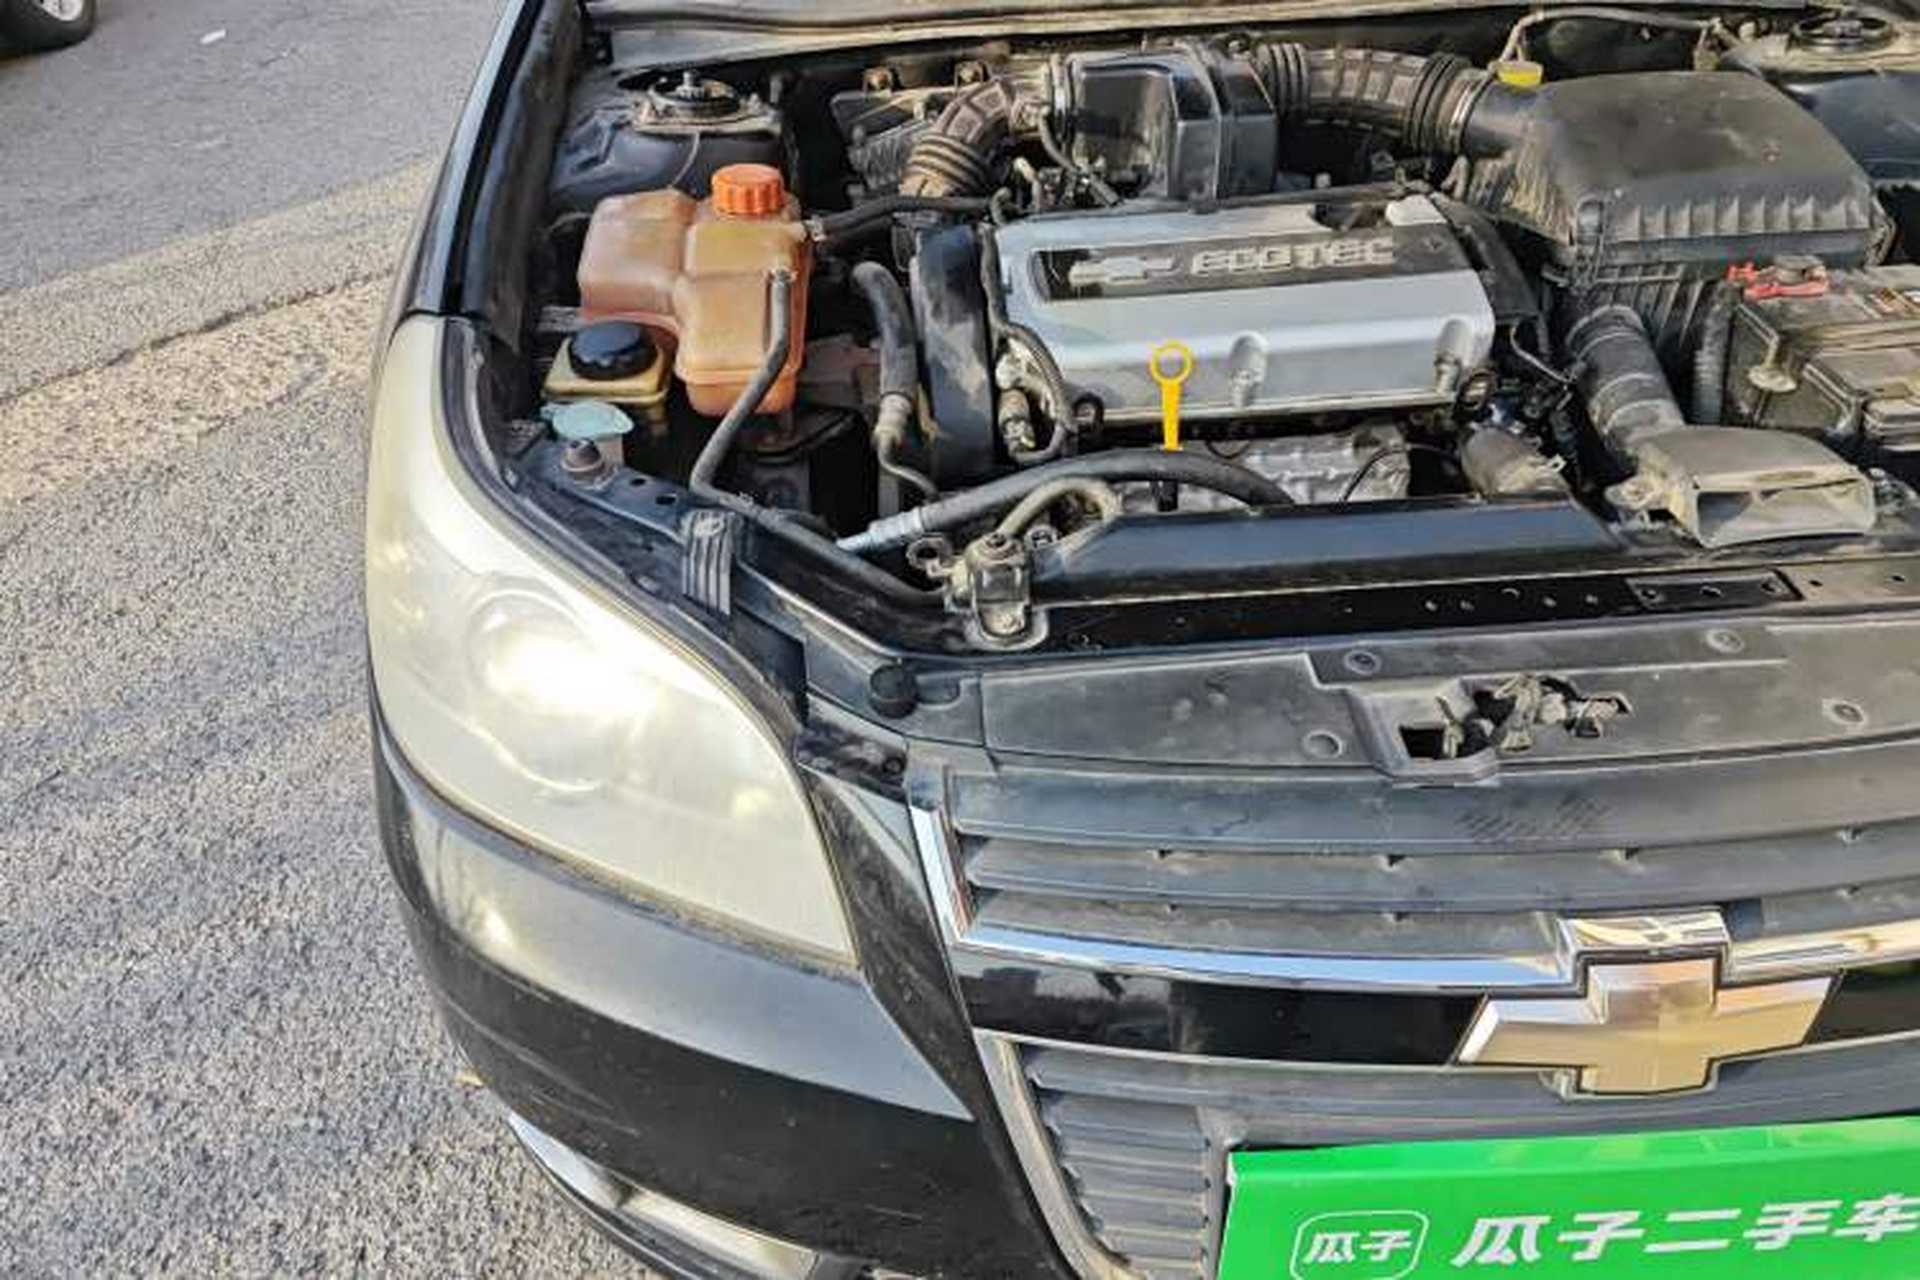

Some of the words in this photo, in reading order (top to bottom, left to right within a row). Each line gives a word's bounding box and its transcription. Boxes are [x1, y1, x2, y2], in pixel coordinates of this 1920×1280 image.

[1302, 1230, 1412, 1264] 瓜子
[1450, 1193, 1920, 1267] 瓜子二手车
